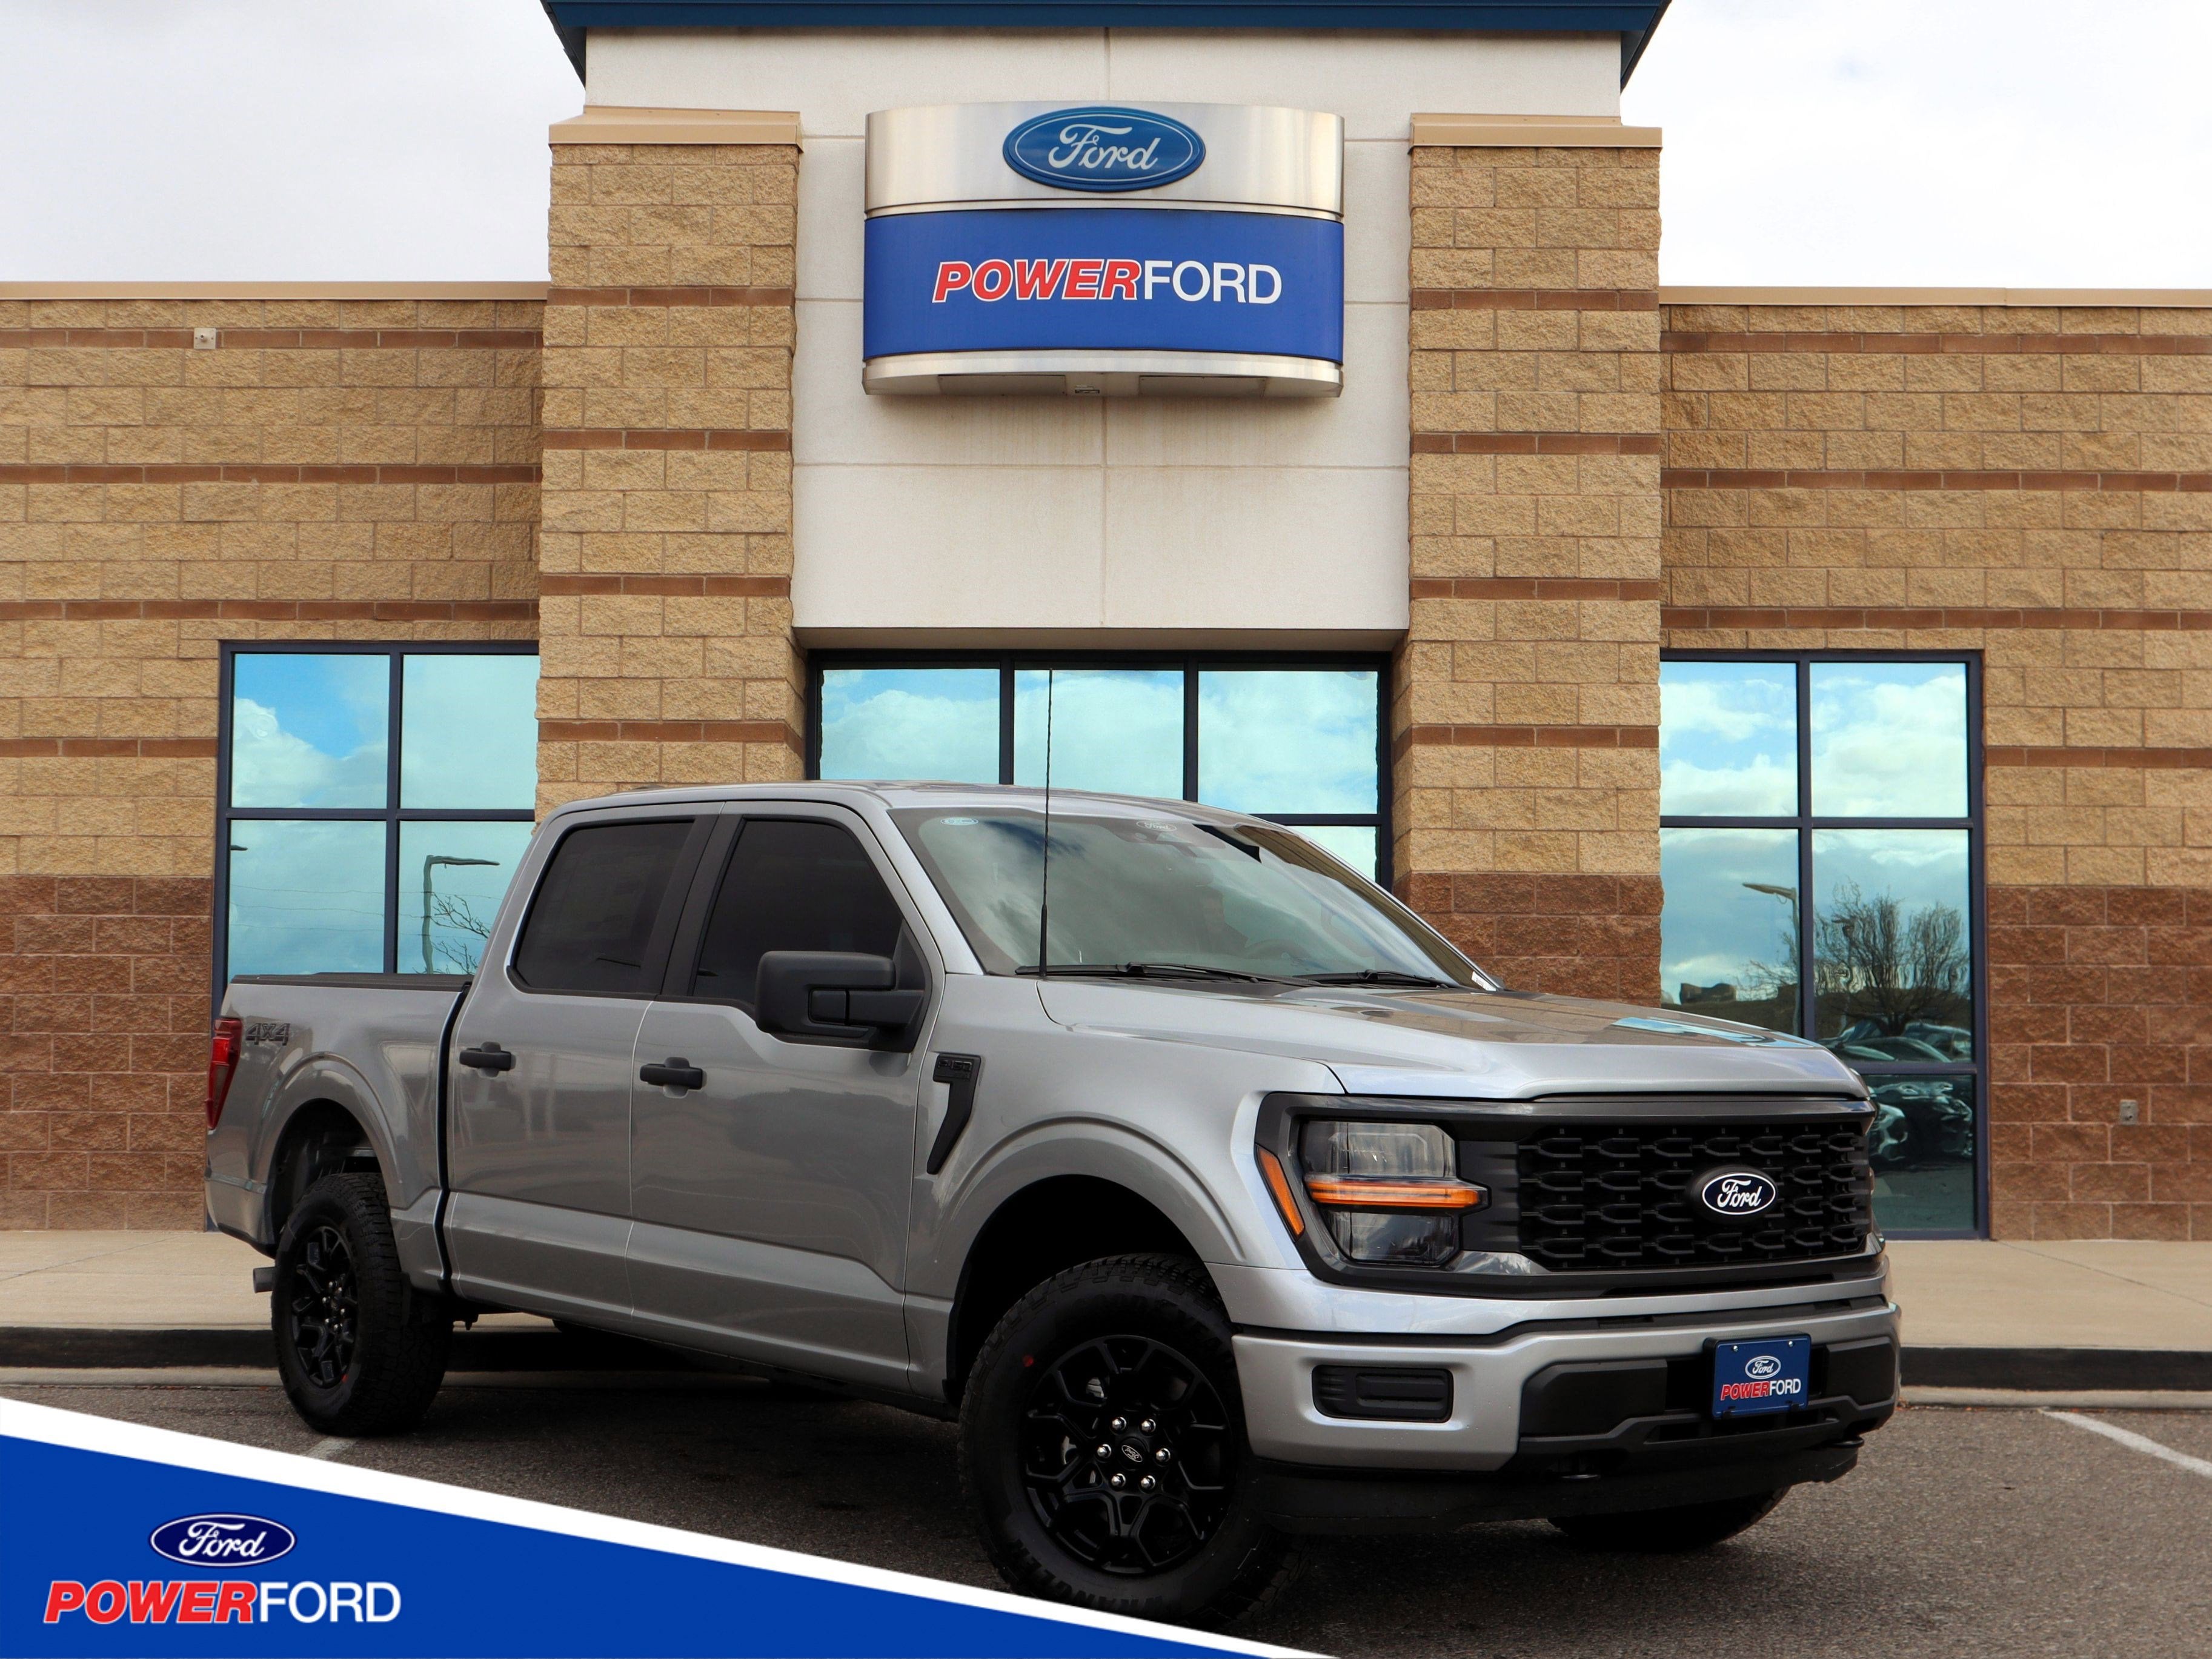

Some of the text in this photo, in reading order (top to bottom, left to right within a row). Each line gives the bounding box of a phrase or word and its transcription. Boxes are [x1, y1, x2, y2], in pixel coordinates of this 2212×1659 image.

[1048, 123, 1160, 170] Ford
[1717, 1179, 1762, 1208] Ford
[1752, 1360, 1774, 1374] Ford
